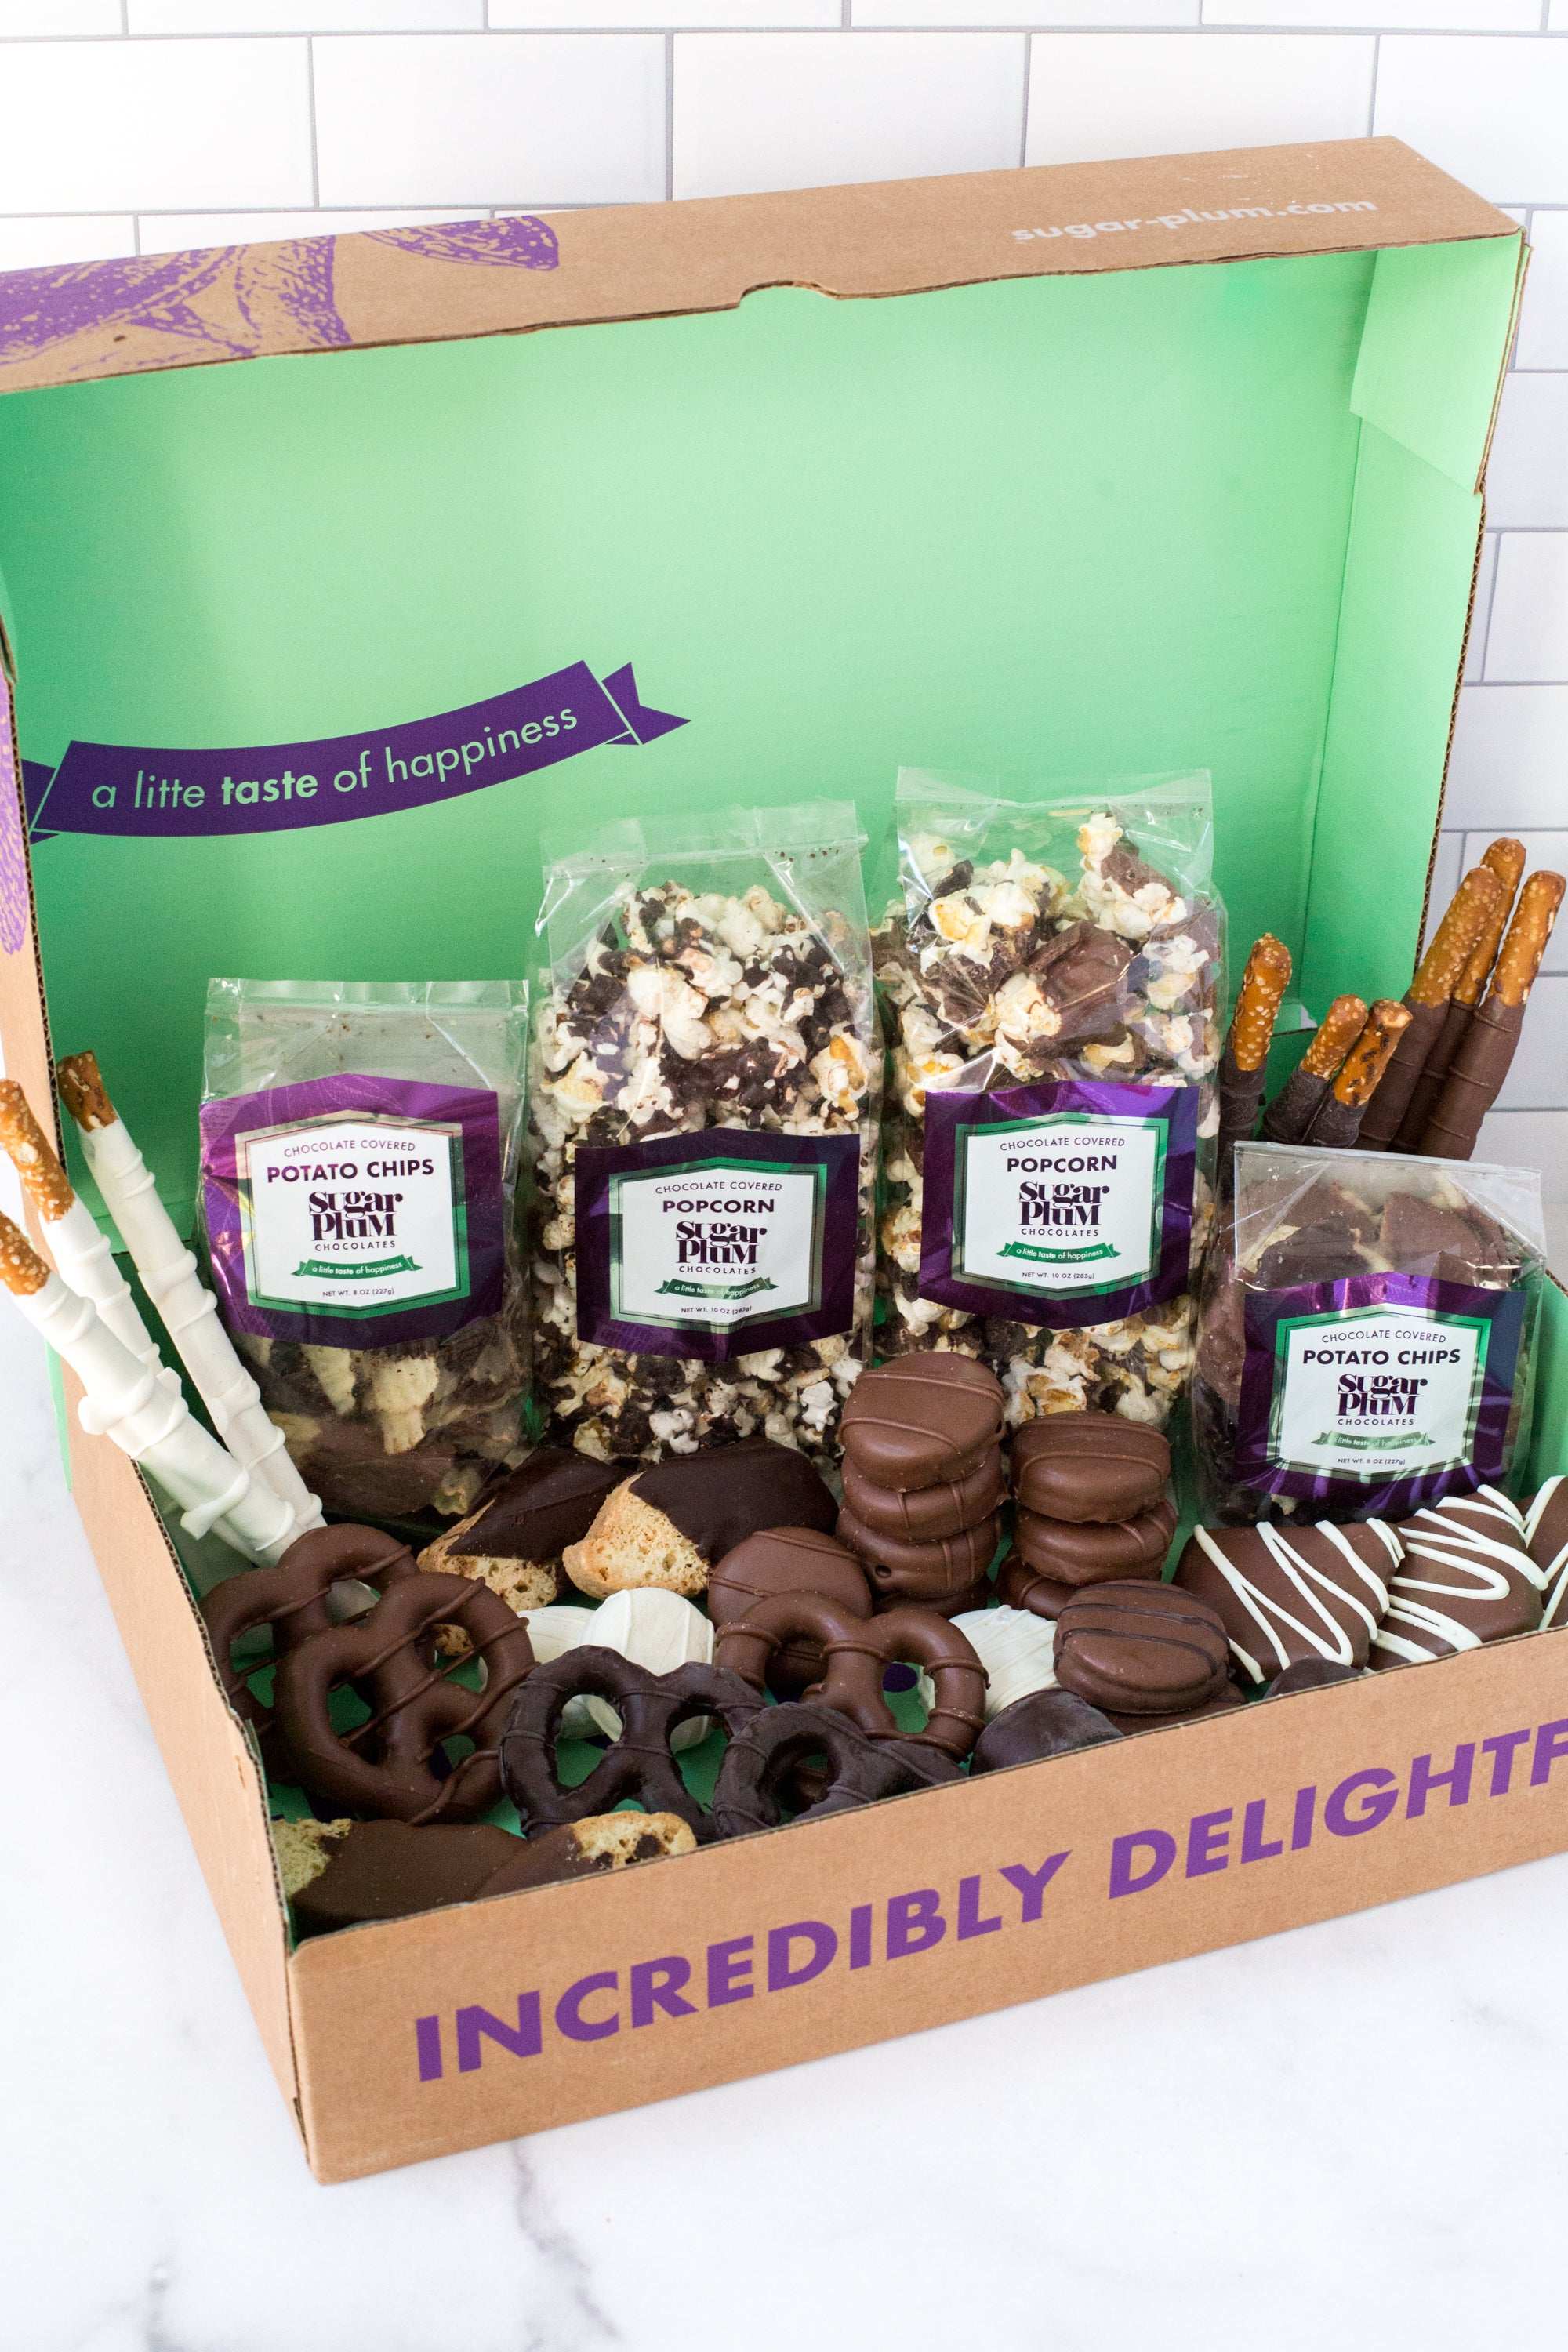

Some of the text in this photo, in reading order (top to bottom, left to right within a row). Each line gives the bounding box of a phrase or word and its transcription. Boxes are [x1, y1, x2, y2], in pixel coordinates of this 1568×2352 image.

[1010, 199, 1379, 242] sugar-plum.com
[92, 707, 578, 808] a litte taste of happiness
[283, 1139, 416, 1158] CHOCOLATE COVERED
[1000, 1137, 1125, 1152] CHOCOLATE COVERED
[267, 1159, 435, 1184] POTATO CHIPS
[1007, 1155, 1118, 1173] POPCORN
[655, 1181, 783, 1195] CHOCOLATE COVERED
[662, 1198, 775, 1214] POPCORN
[1021, 1228, 1099, 1237] CHOCOLATES
[314, 1240, 396, 1252] CHOCOLATES
[1022, 1247, 1038, 1258] little
[1067, 1249, 1104, 1261] happiness
[318, 1265, 335, 1275] little
[335, 1266, 354, 1276] taste
[355, 1266, 365, 1275] of
[365, 1261, 403, 1275] happiness
[678, 1265, 757, 1275] CHOCOLATES
[372, 1287, 394, 1296] (227g)
[1321, 1330, 1446, 1344] CHOCOLATE COVERED
[1302, 1348, 1461, 1365] POTATO CHIPS
[415, 1718, 1568, 2082] INCREDIBLY DELIGHTF
